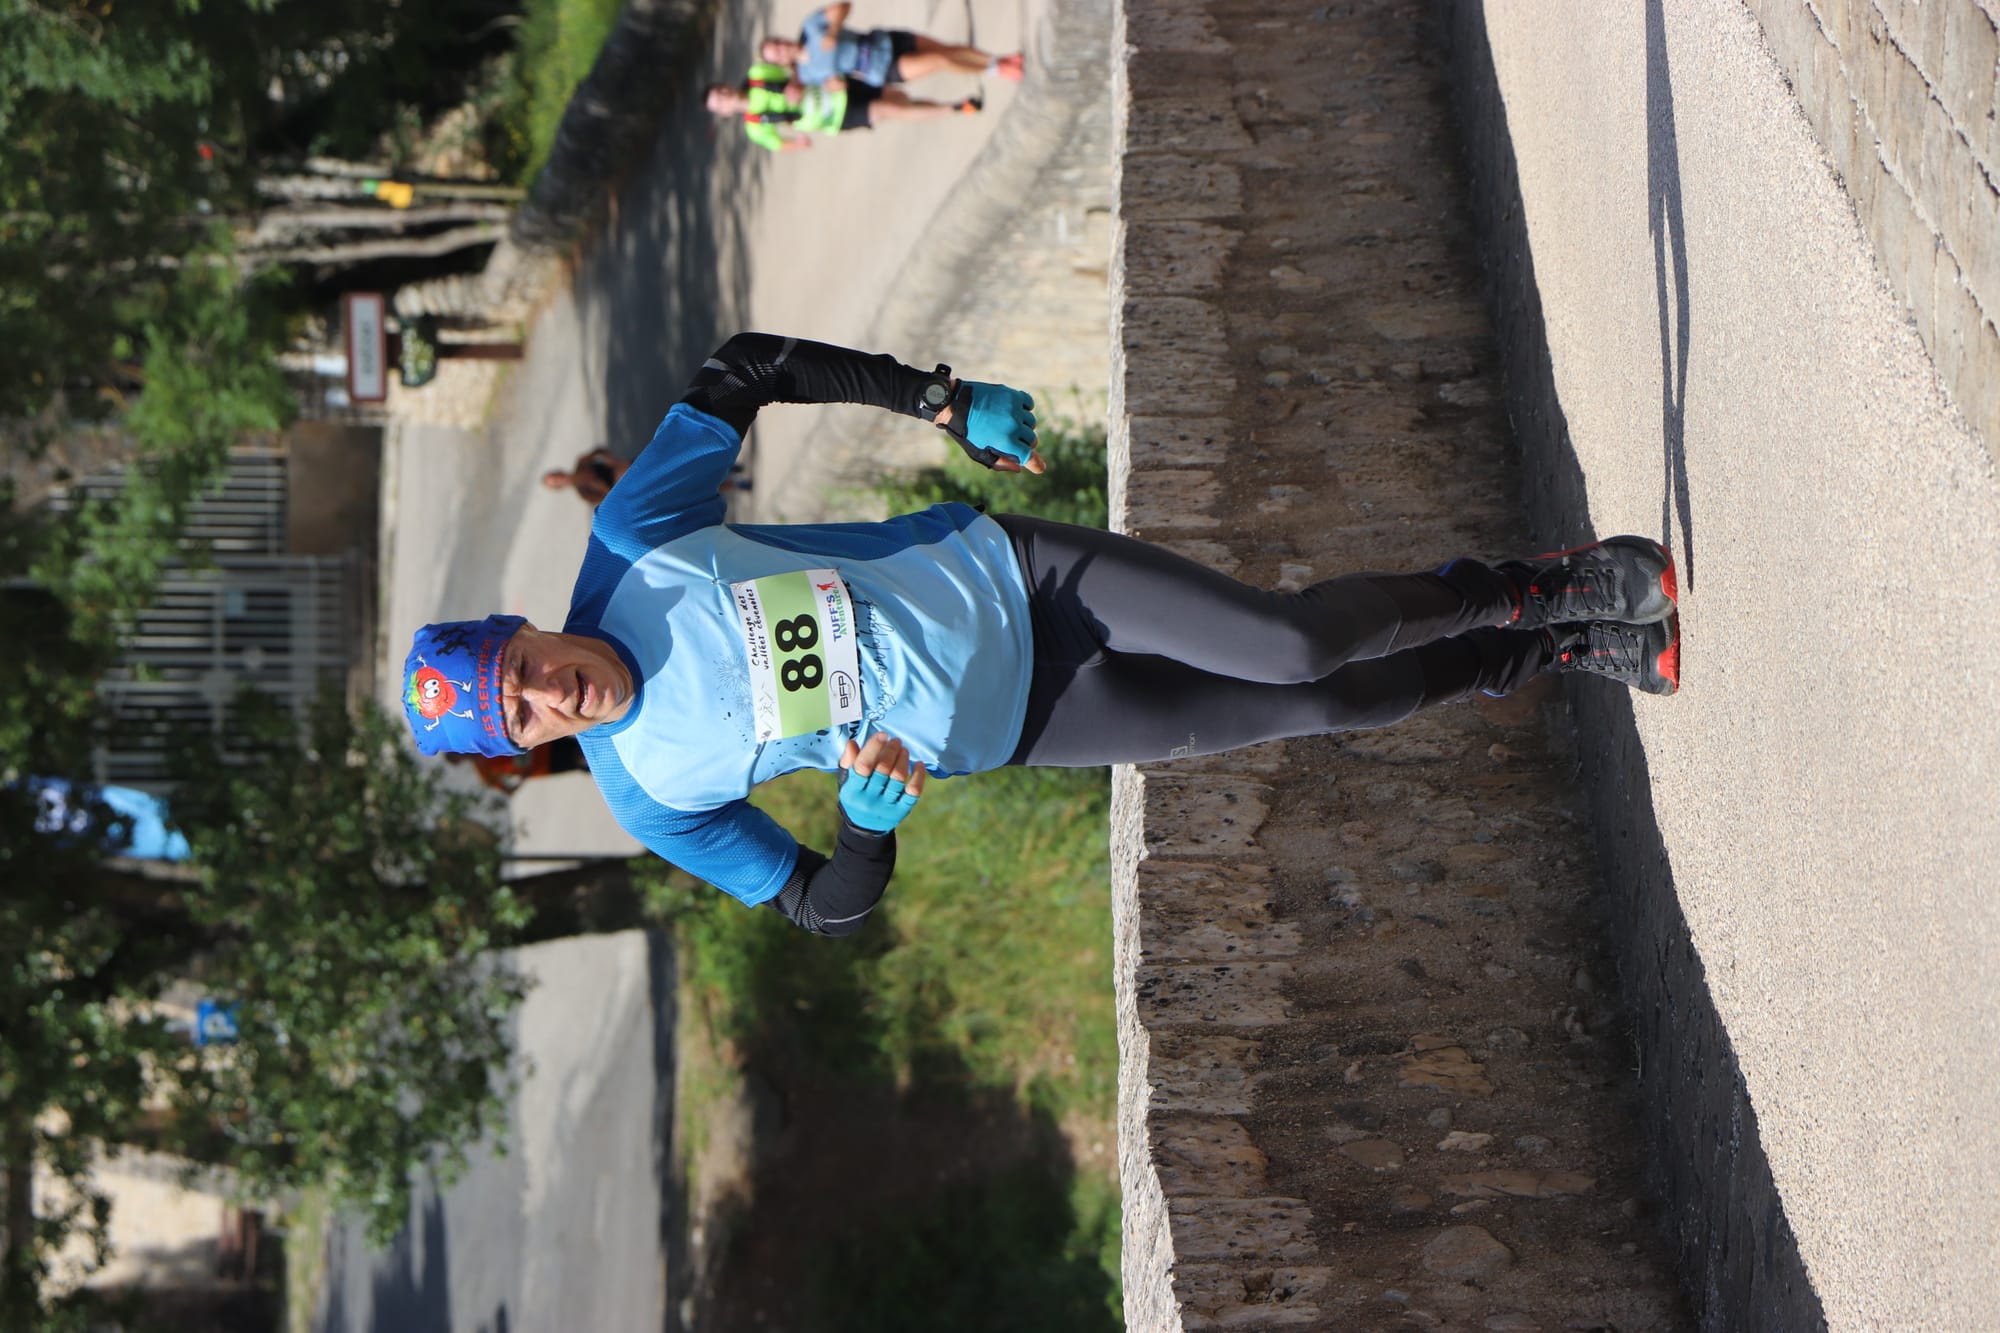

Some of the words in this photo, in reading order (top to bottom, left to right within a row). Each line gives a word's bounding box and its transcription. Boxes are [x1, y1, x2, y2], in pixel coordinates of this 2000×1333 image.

[738, 595, 749, 611] des
[746, 588, 762, 628] cévenoles
[827, 595, 841, 641] TUFF'S
[833, 590, 847, 634] Aventure
[746, 616, 760, 665] Challenge
[759, 636, 769, 669] vallées
[775, 614, 823, 691] 88
[478, 640, 493, 710] SENTIER
[839, 676, 848, 708] BFP
[482, 715, 498, 737] LES
